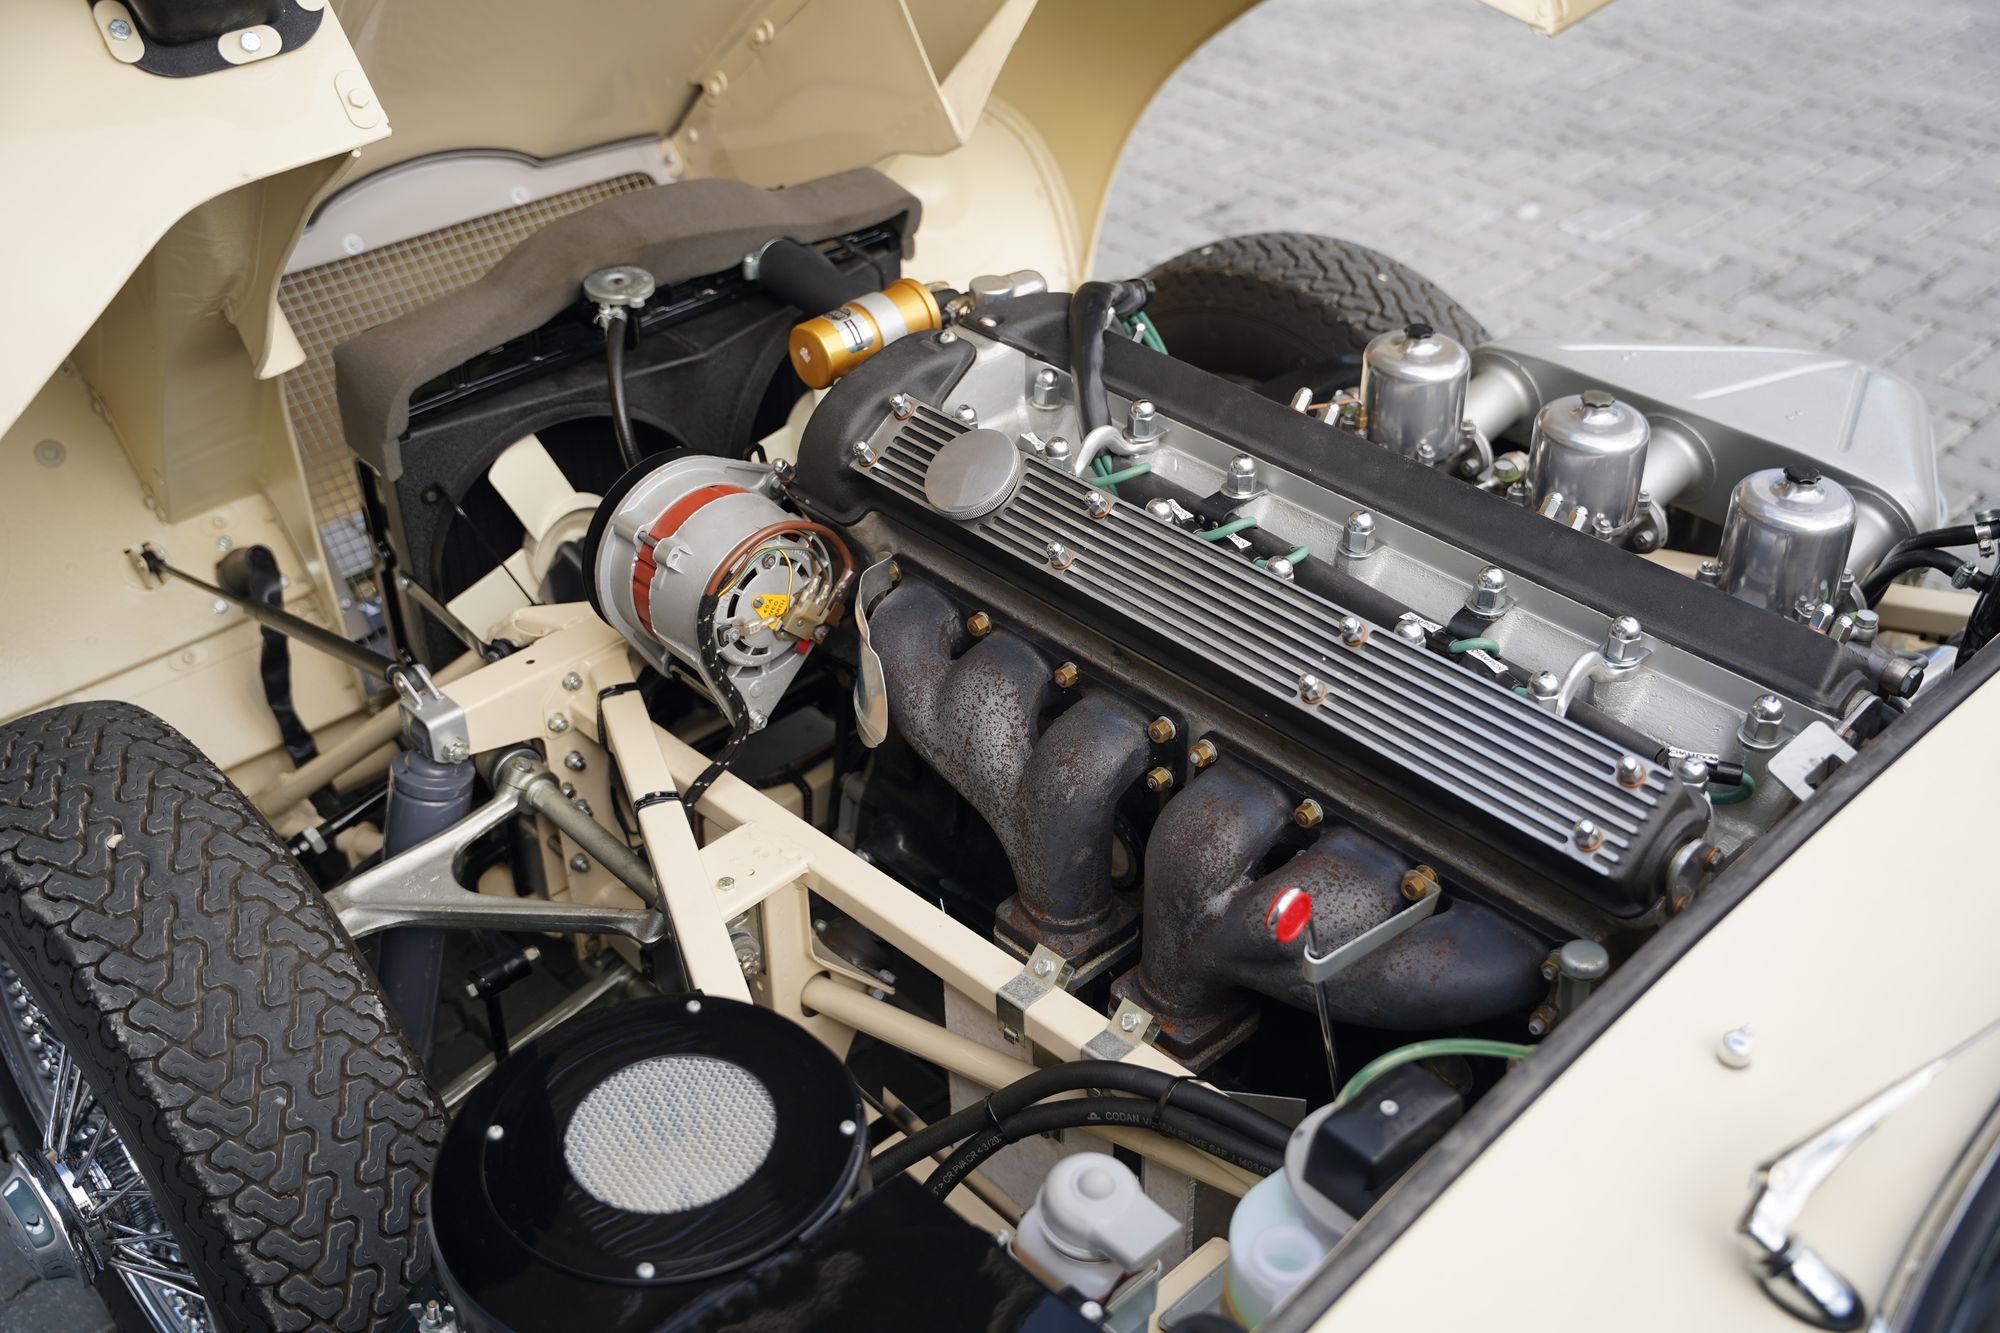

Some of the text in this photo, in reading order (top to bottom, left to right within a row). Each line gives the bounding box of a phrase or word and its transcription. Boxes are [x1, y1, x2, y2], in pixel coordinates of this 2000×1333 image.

[1106, 1111, 1140, 1122] CODAN
[1209, 1144, 1228, 1156] SAE
[952, 1157, 968, 1175] PVA
